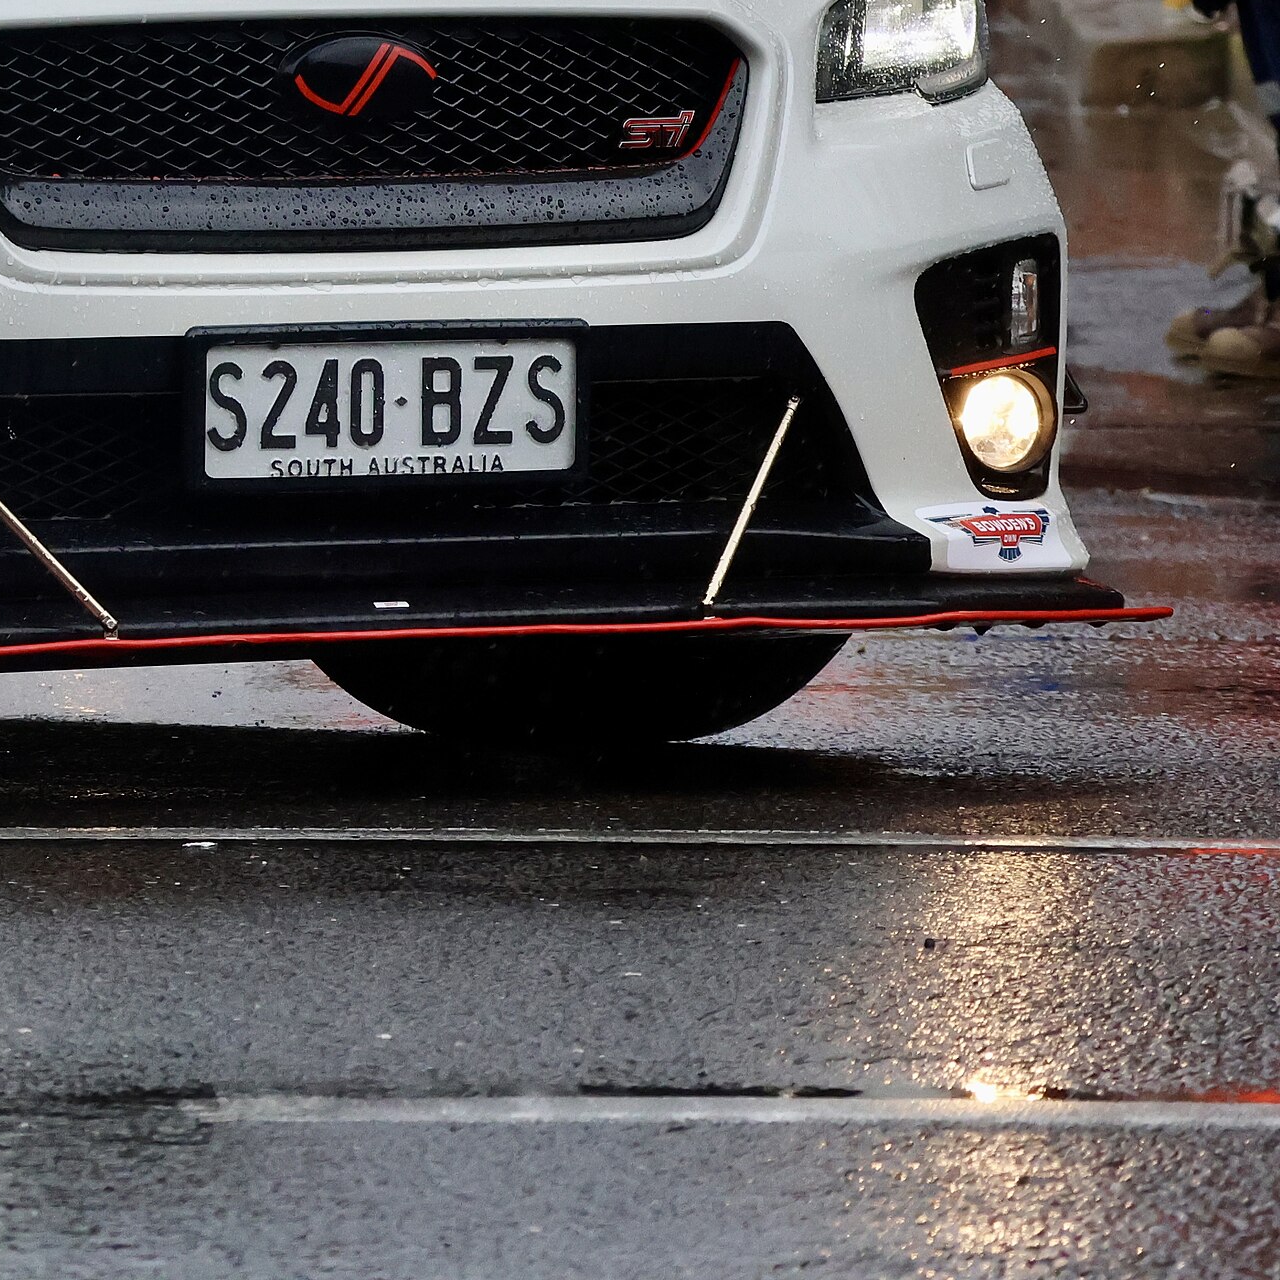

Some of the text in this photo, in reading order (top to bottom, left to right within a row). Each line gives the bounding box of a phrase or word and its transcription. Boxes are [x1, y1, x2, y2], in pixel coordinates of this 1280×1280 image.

[270, 454, 505, 477] SOUTH AUSTRALIA
[970, 517, 1037, 532] BOWDEN'S
